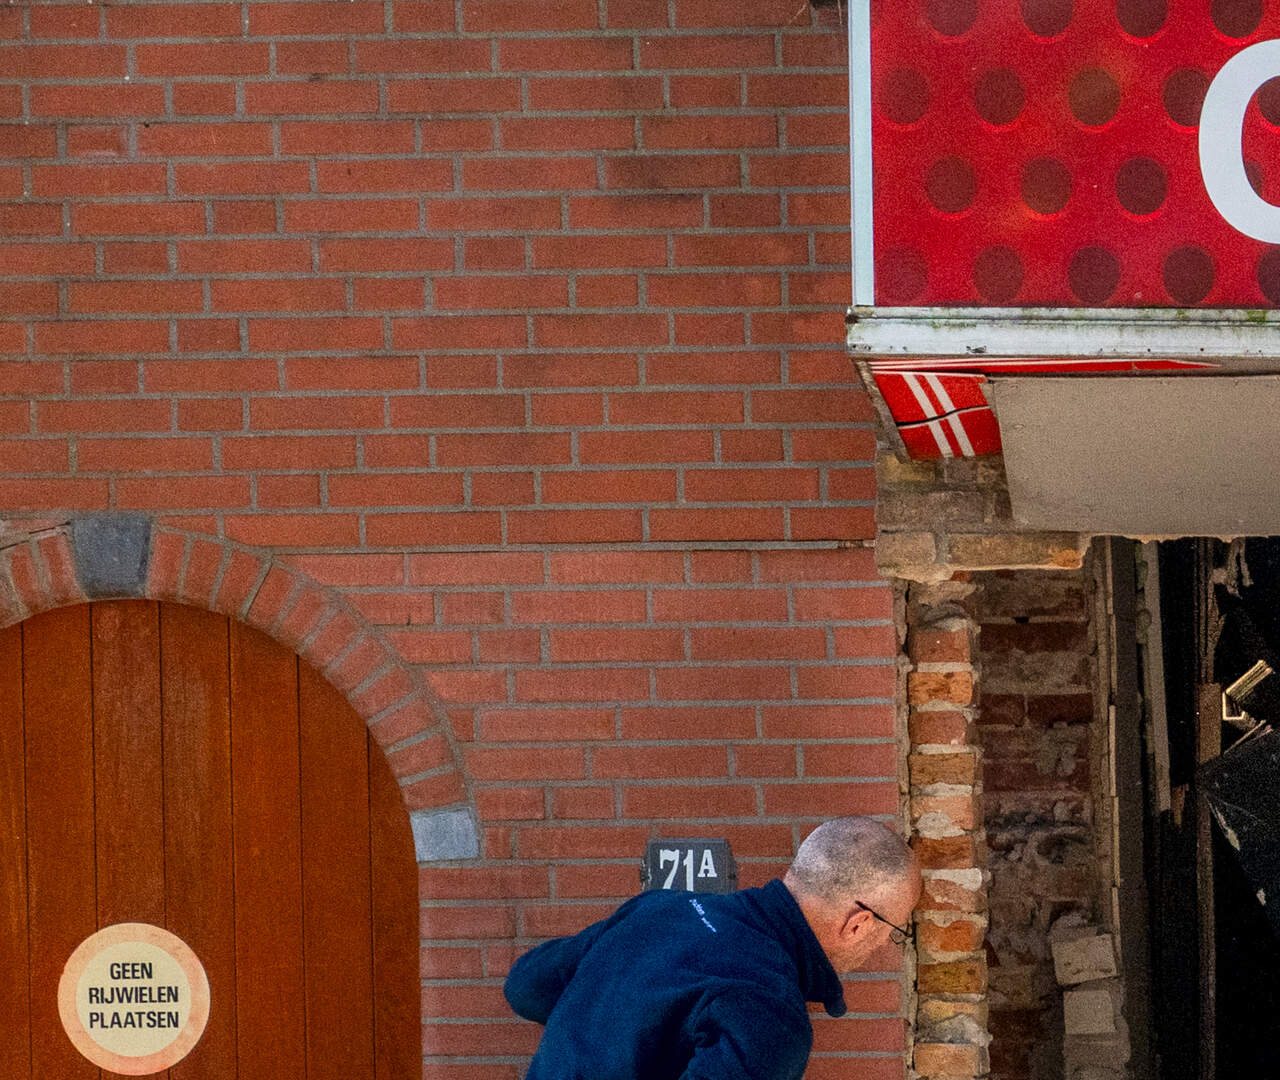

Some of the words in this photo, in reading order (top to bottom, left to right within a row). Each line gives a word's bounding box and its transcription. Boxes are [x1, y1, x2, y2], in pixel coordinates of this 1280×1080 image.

[660, 849, 718, 892] 71A
[110, 962, 153, 979] GEEN
[88, 986, 179, 1004] RIJWIELEN
[89, 1011, 179, 1028] PLAATSEN
